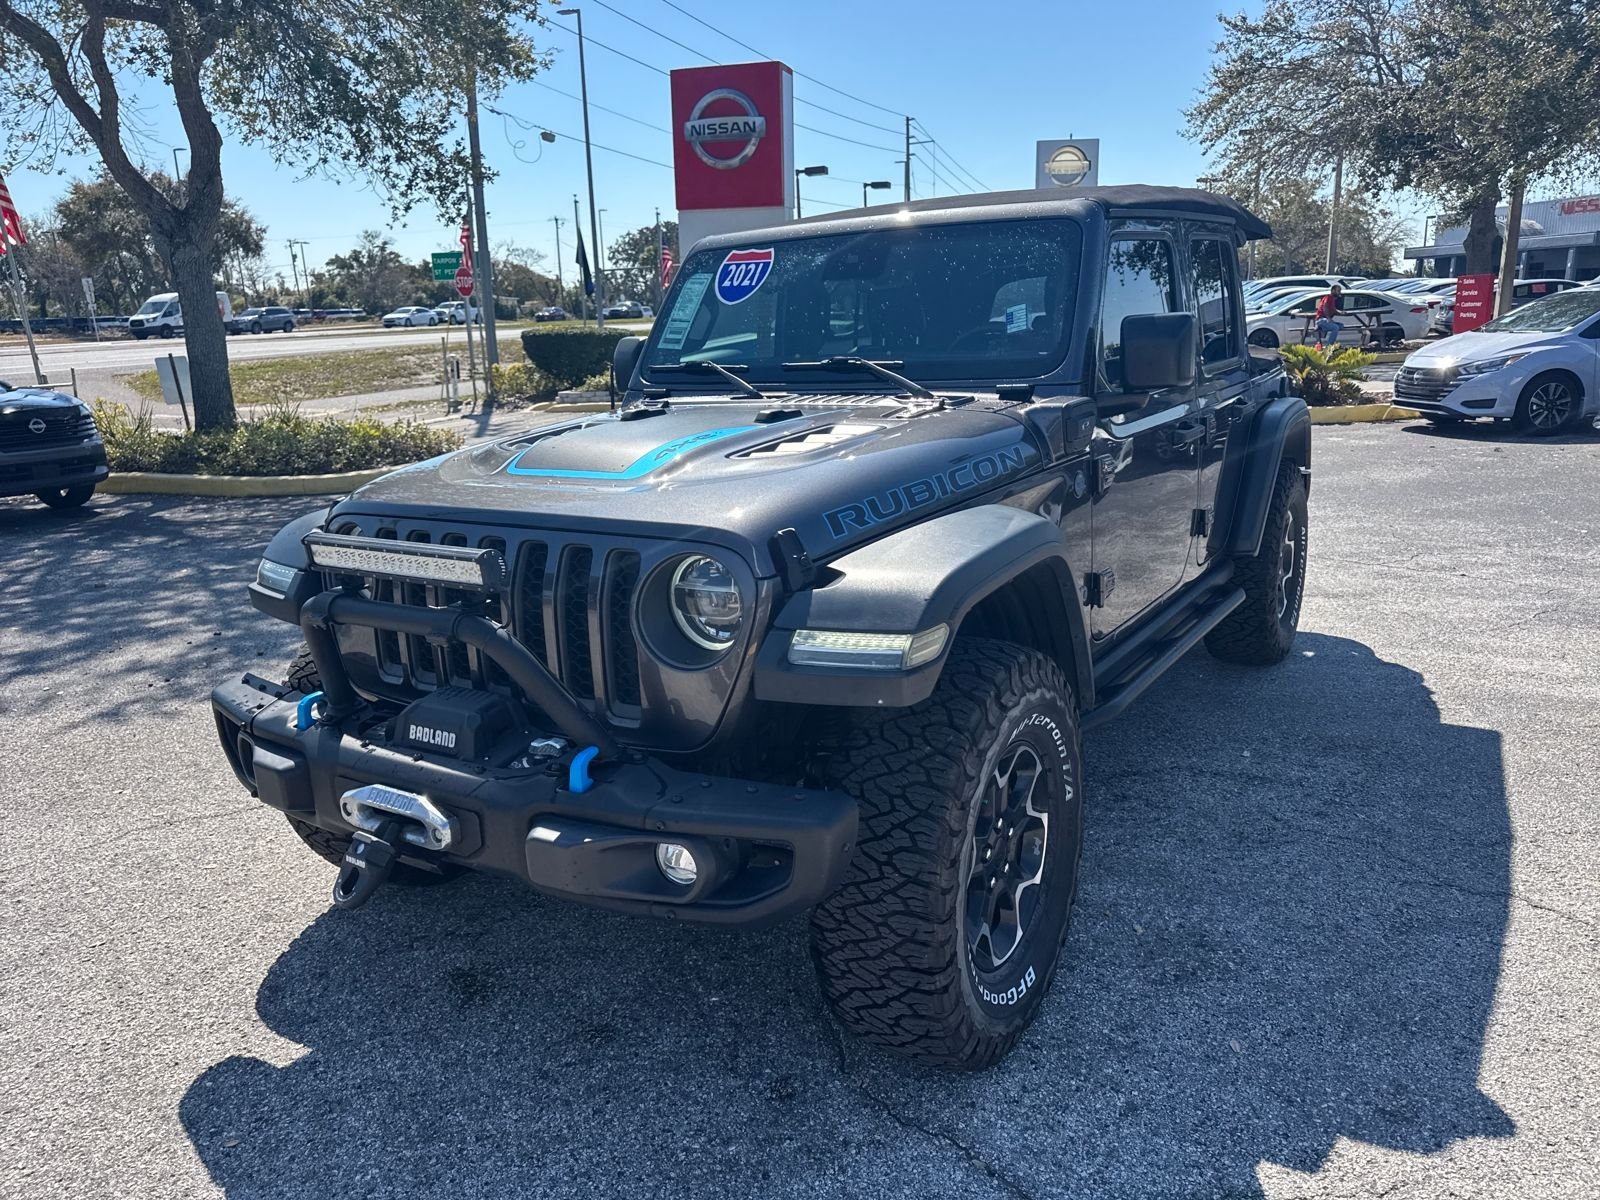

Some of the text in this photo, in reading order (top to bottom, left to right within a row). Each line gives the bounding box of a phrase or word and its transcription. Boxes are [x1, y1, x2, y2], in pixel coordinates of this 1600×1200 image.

[690, 121, 756, 136] NISSAN
[456, 276, 473, 288] STOP
[721, 263, 764, 287] 2021
[822, 446, 1026, 540] RUBICON
[409, 724, 457, 749] BADLAND
[1007, 713, 1074, 802] All-Terrain T/A
[367, 787, 415, 813] BADLAND
